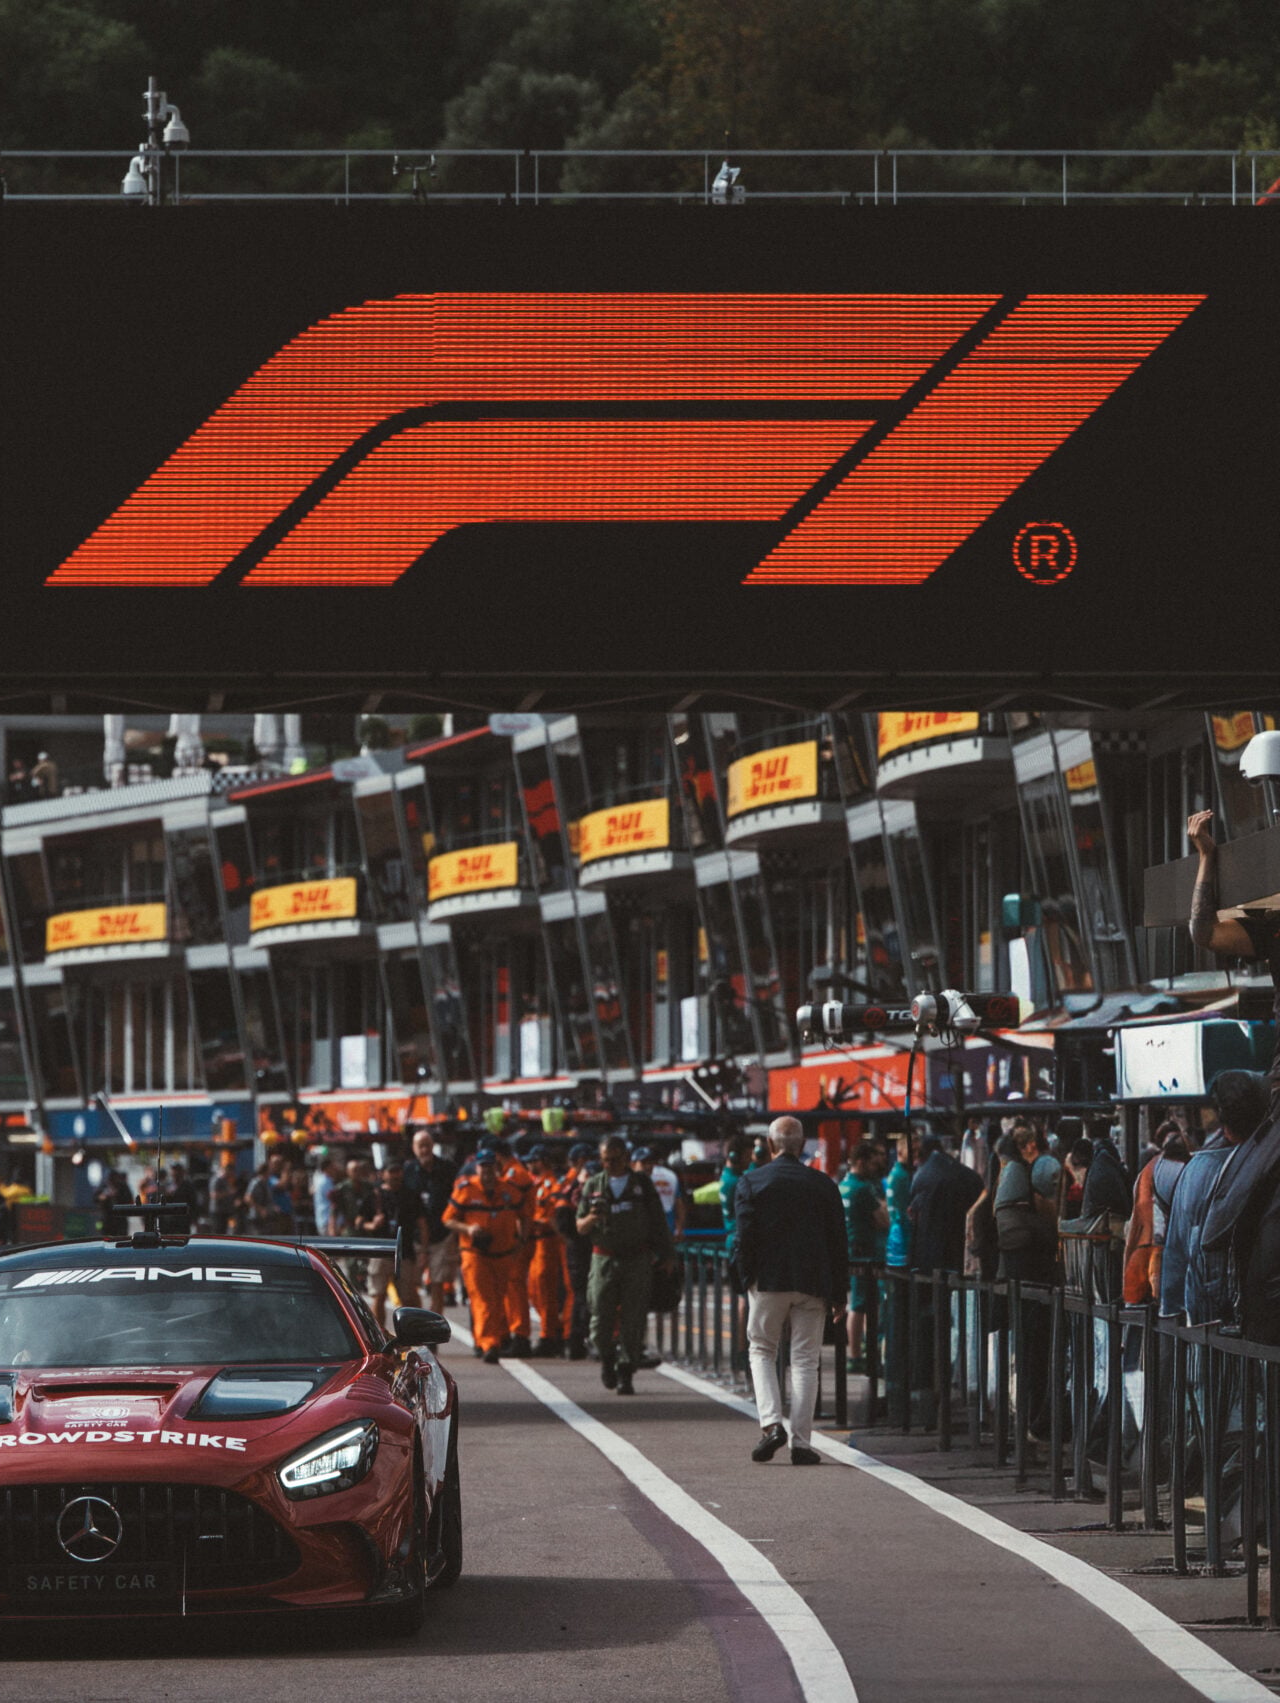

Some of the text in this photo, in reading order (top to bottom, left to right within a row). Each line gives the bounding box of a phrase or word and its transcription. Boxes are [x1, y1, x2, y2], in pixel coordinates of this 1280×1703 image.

[97, 912, 140, 935] DHL
[886, 1010, 911, 1021] TG
[89, 1267, 263, 1284] AMG
[27, 1574, 157, 1590] SAFETY CAR
